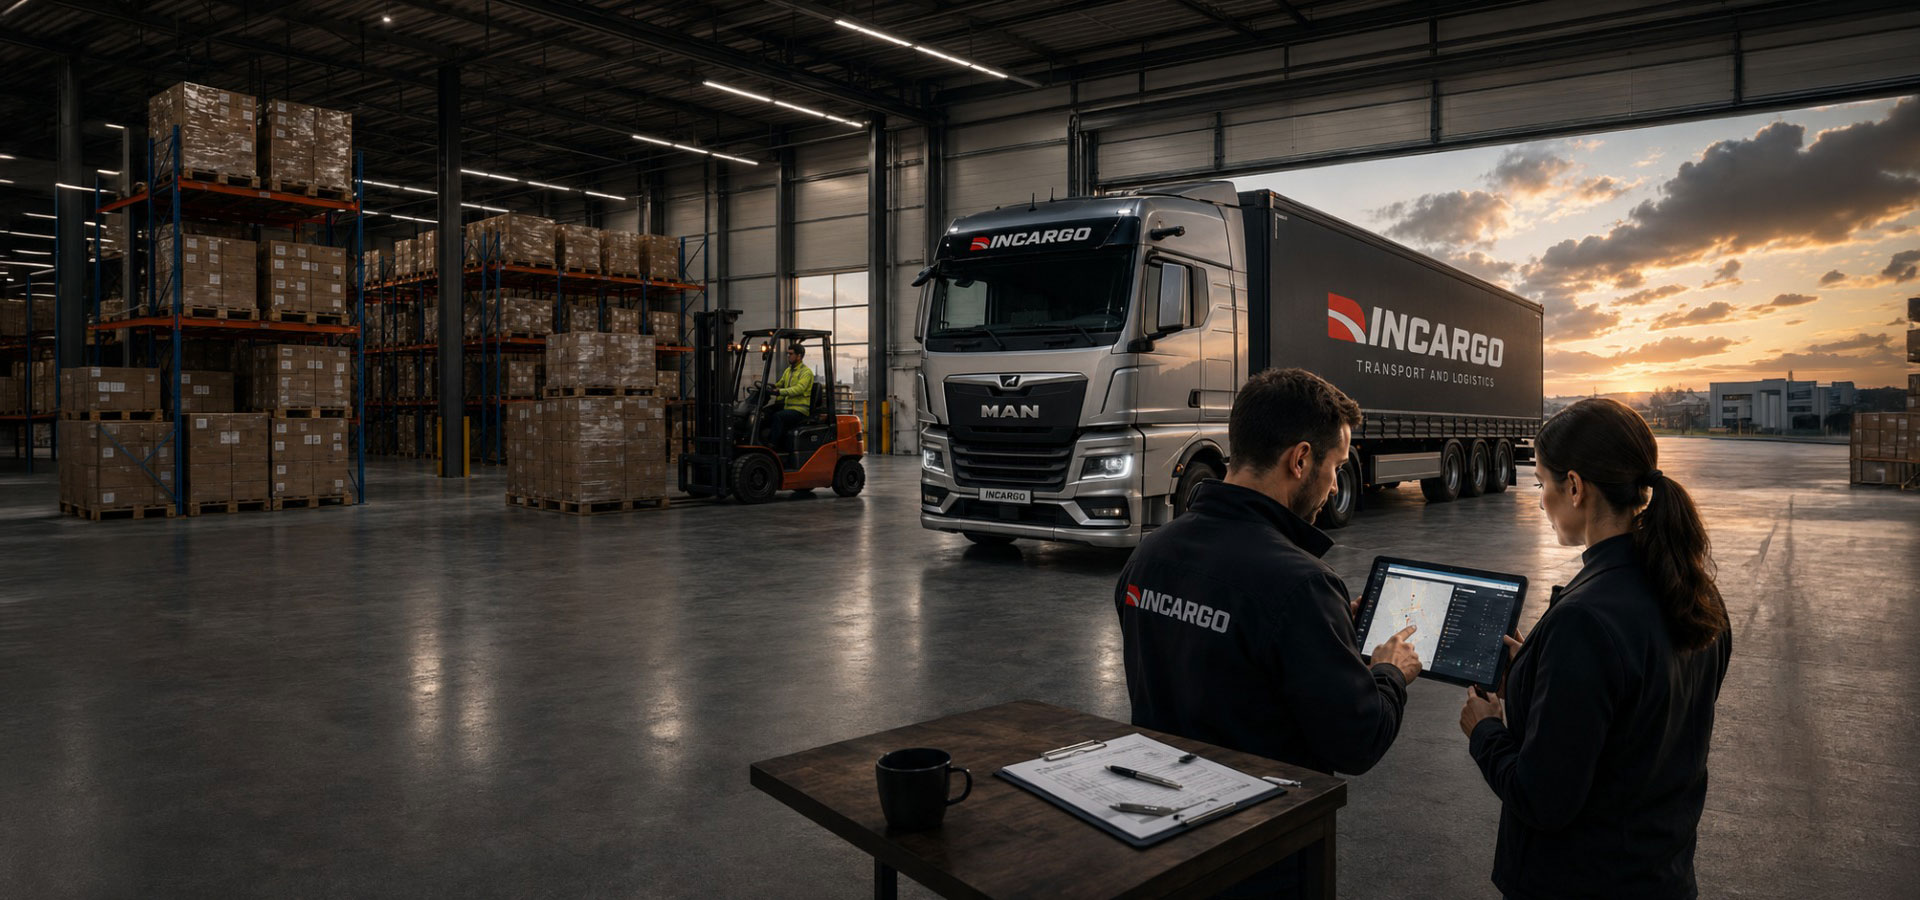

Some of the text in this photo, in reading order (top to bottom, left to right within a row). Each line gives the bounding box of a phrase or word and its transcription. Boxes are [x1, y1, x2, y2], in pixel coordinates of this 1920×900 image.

[990, 227, 1092, 249] INCARGO
[1368, 306, 1504, 368] INCARGO
[1356, 359, 1495, 388] TRANSPORT AND LOGISTICS
[981, 405, 1039, 418] MAN
[985, 490, 1026, 501] INCARGO
[1140, 589, 1231, 633] INCARGO
